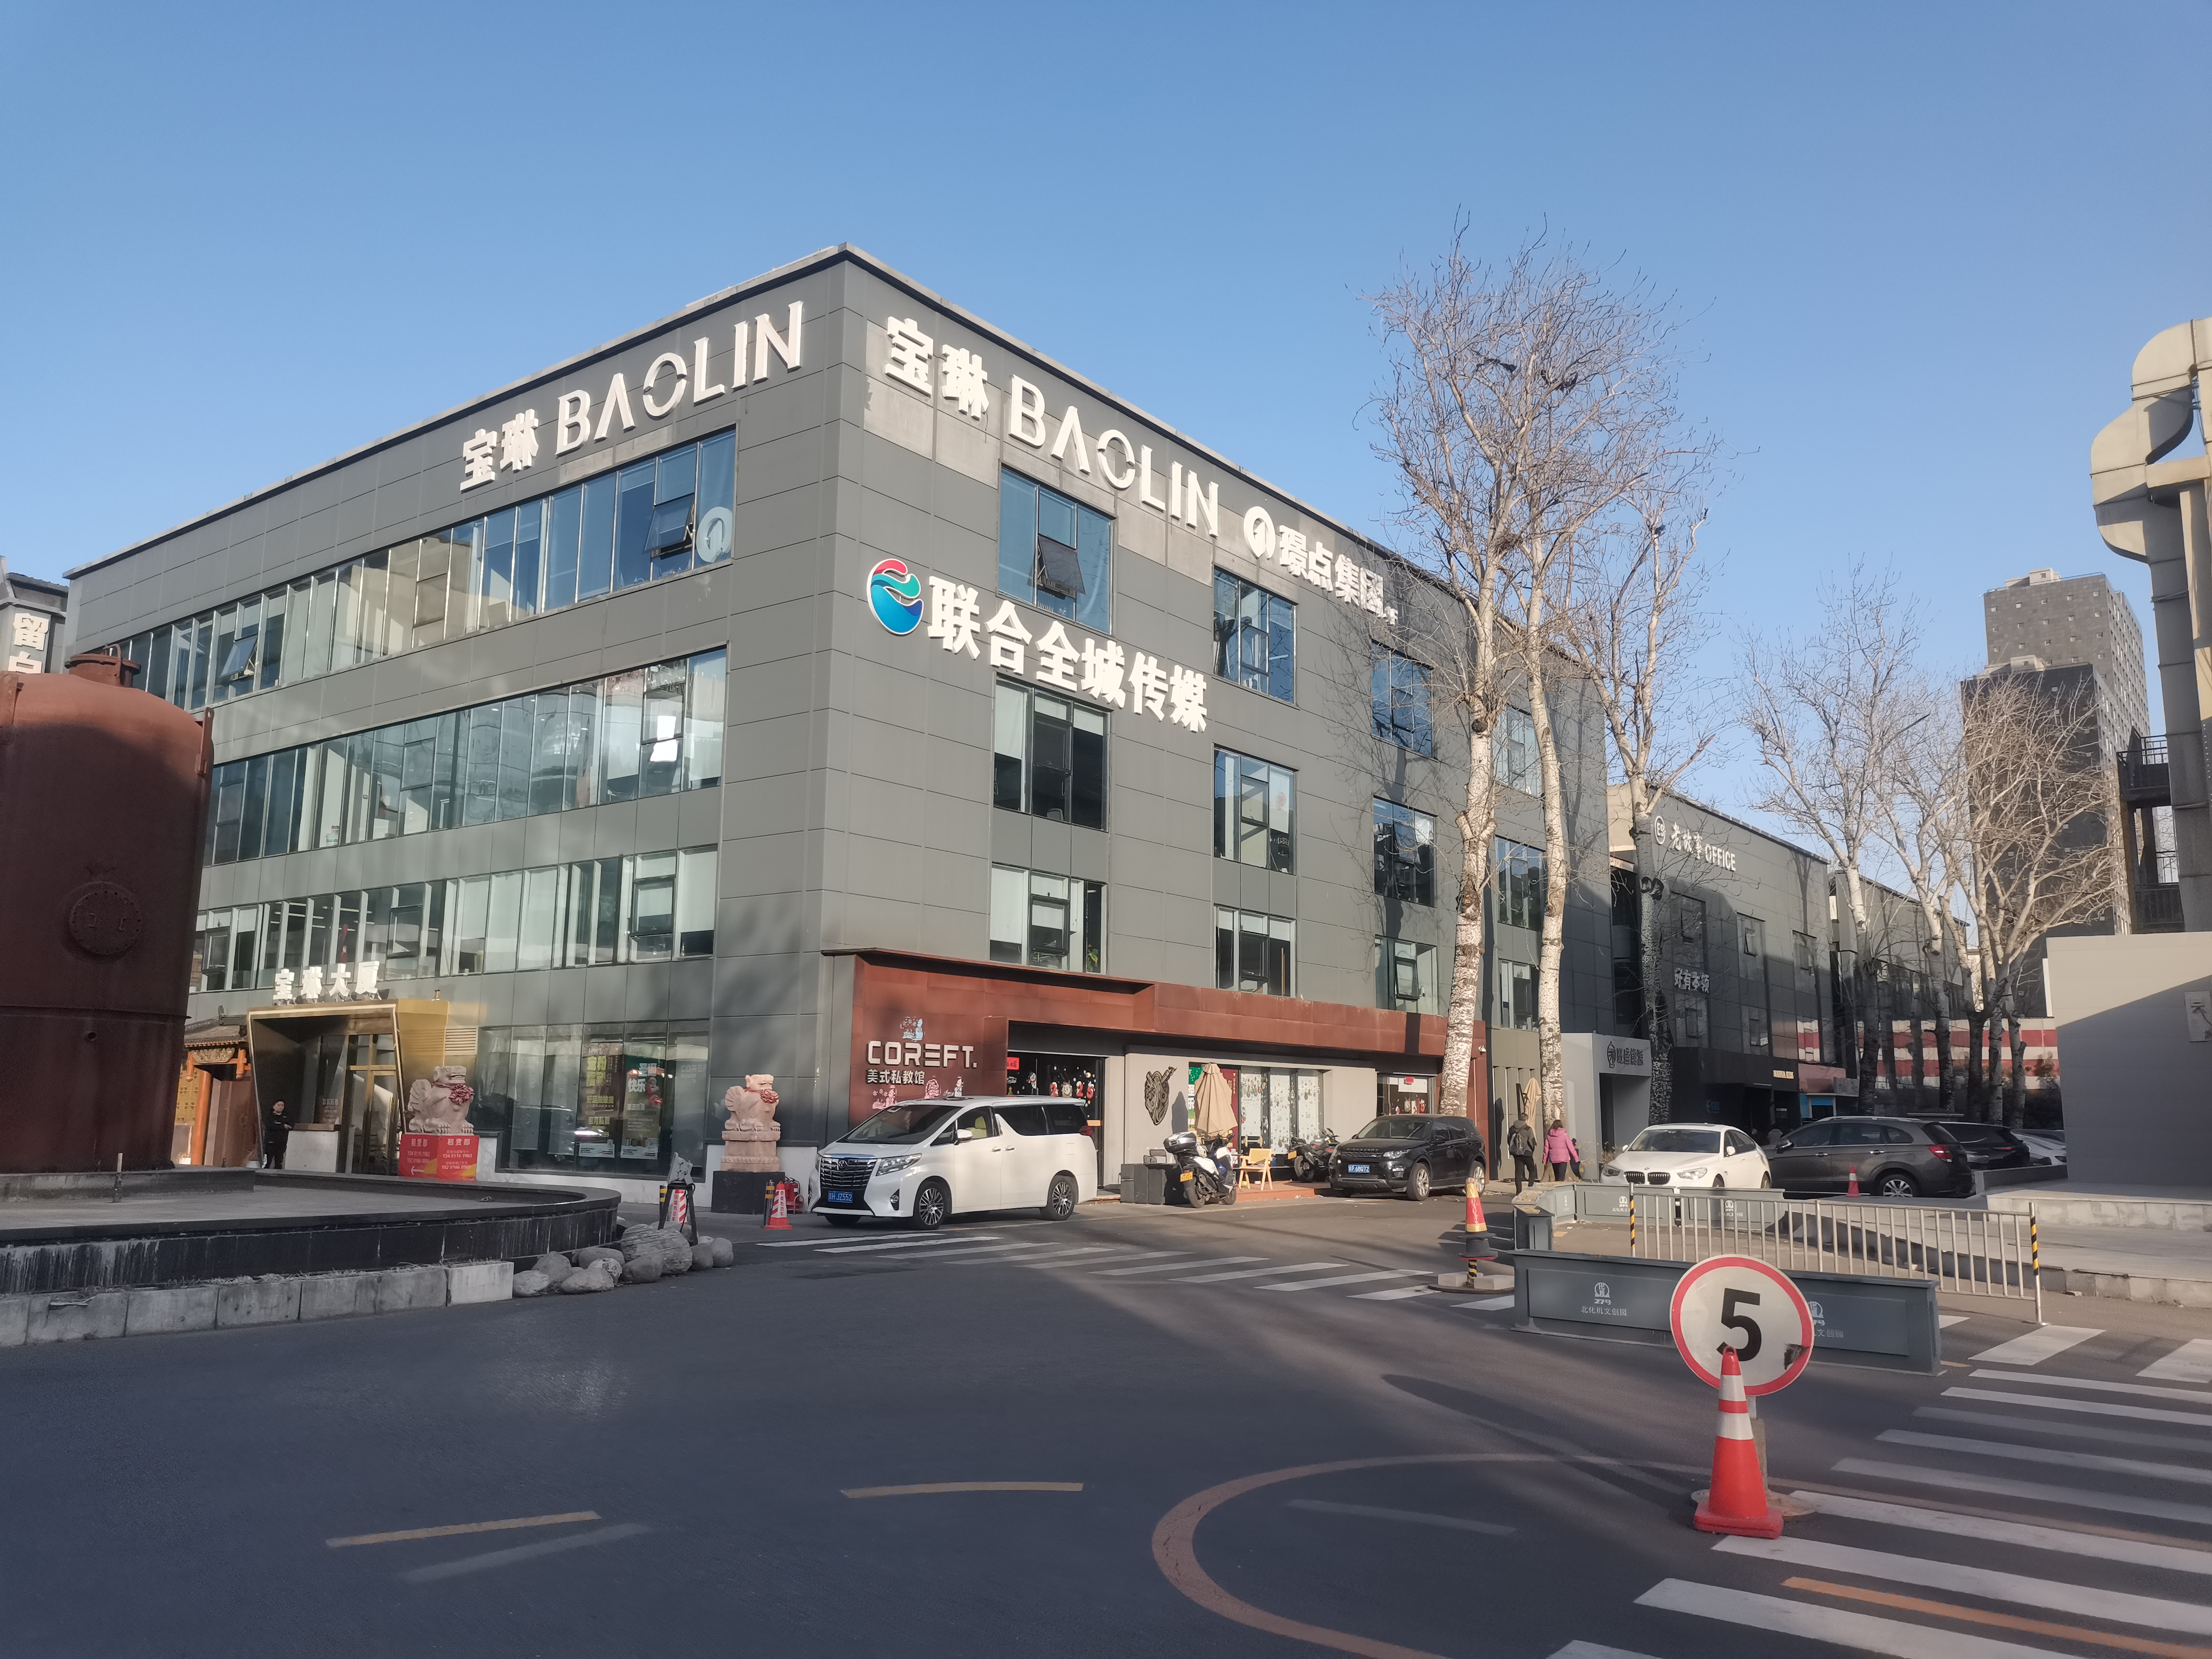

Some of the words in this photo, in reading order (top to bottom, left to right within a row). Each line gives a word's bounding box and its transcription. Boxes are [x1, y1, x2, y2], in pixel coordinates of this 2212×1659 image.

[460, 409, 539, 491] 宝琳
[556, 301, 804, 457] BAOLIN
[885, 316, 989, 421] 宝琳
[1008, 374, 1219, 538] BAOLIN
[927, 576, 1208, 733] 联合全城传媒
[1705, 843, 1736, 872] OFFICE
[273, 961, 380, 1000] 宝琳大厦
[628, 1078, 646, 1093] 快乐
[866, 1069, 925, 1085] 美式私教馆
[1581, 1305, 1627, 1316] 北化机文创园
[1716, 1287, 1762, 1362] 5
